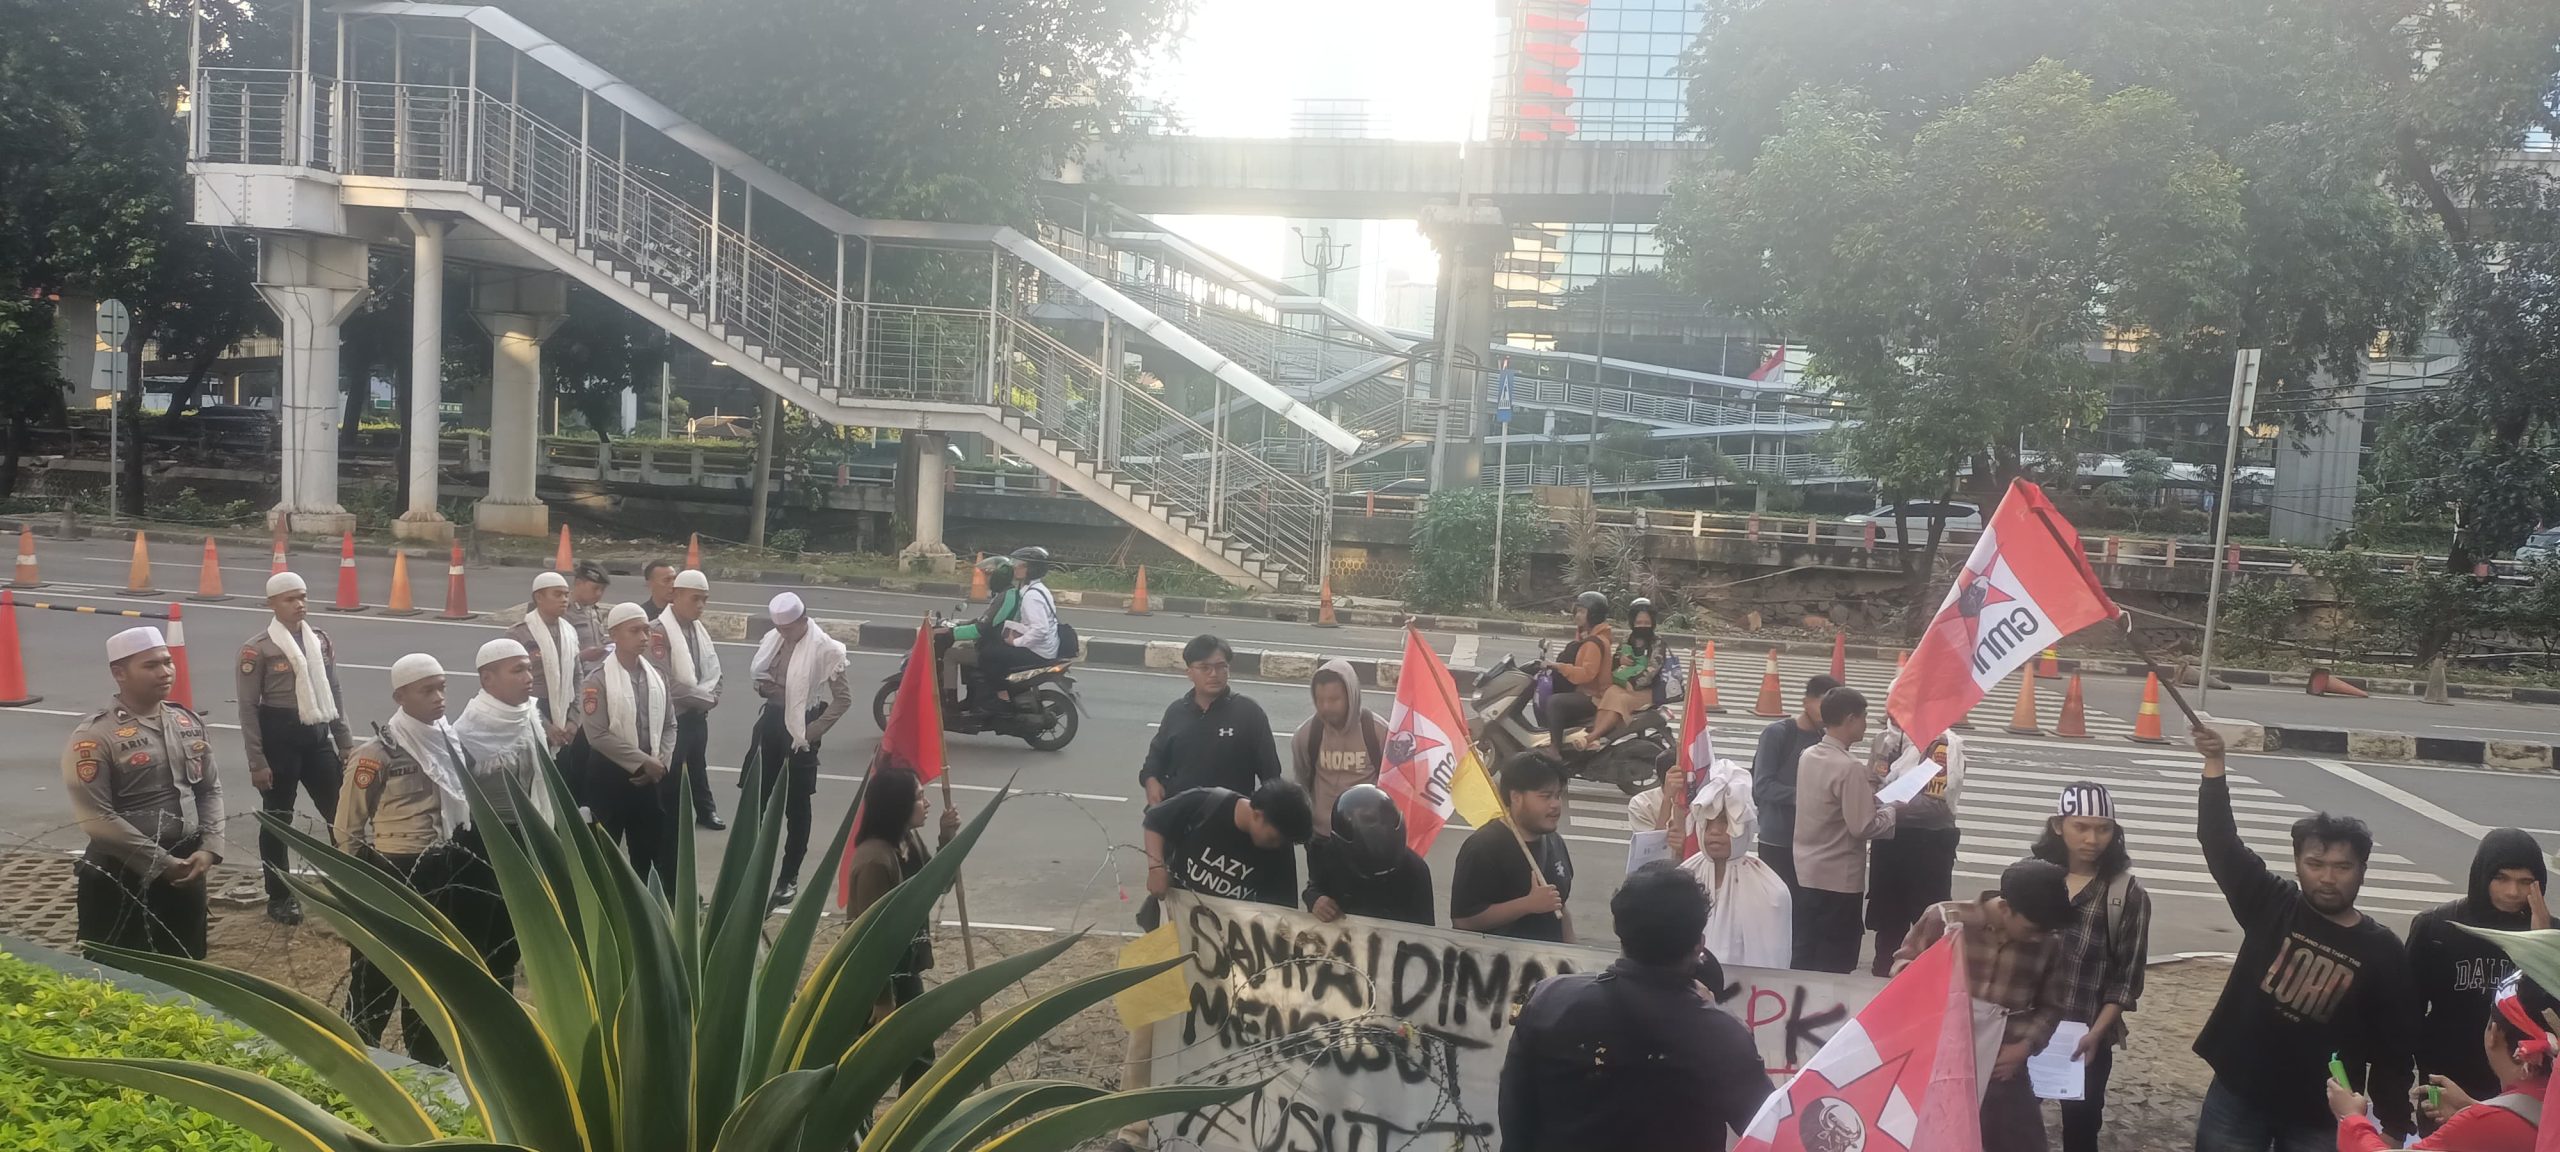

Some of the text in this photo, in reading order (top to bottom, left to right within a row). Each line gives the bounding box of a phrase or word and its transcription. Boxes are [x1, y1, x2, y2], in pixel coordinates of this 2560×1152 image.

[1320, 751, 1366, 770] HOPE
[1187, 857, 1254, 899] SUNDAY
[1200, 847, 1254, 880] LAZY
[1190, 905, 1381, 1012] SAMPAI
[2260, 937, 2354, 1022] LORD
